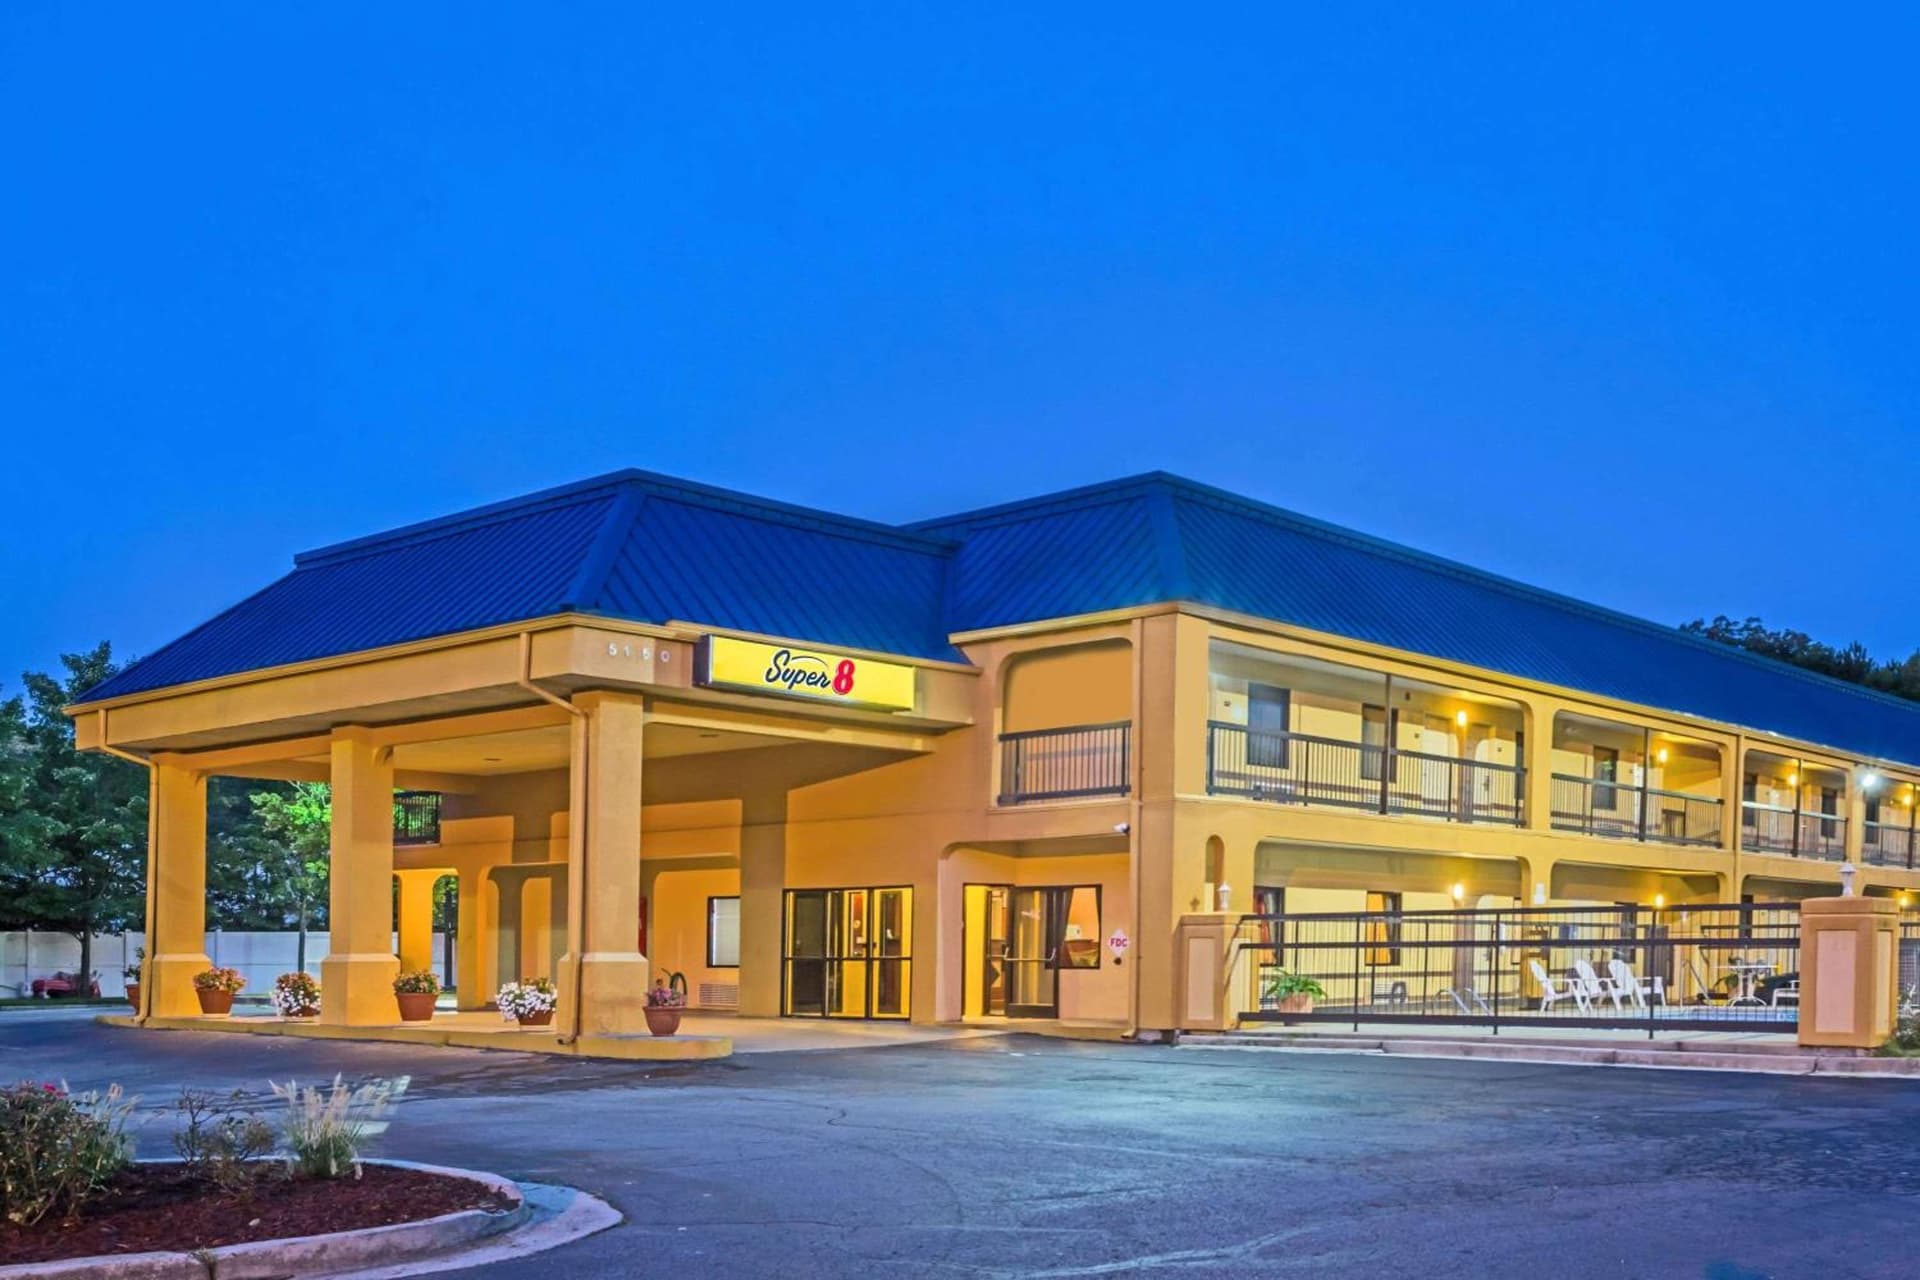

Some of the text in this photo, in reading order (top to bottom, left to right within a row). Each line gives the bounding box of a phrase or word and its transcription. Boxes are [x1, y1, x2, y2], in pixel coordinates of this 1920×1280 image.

[765, 649, 855, 695] Super 8
[1110, 937, 1128, 947] FDC
